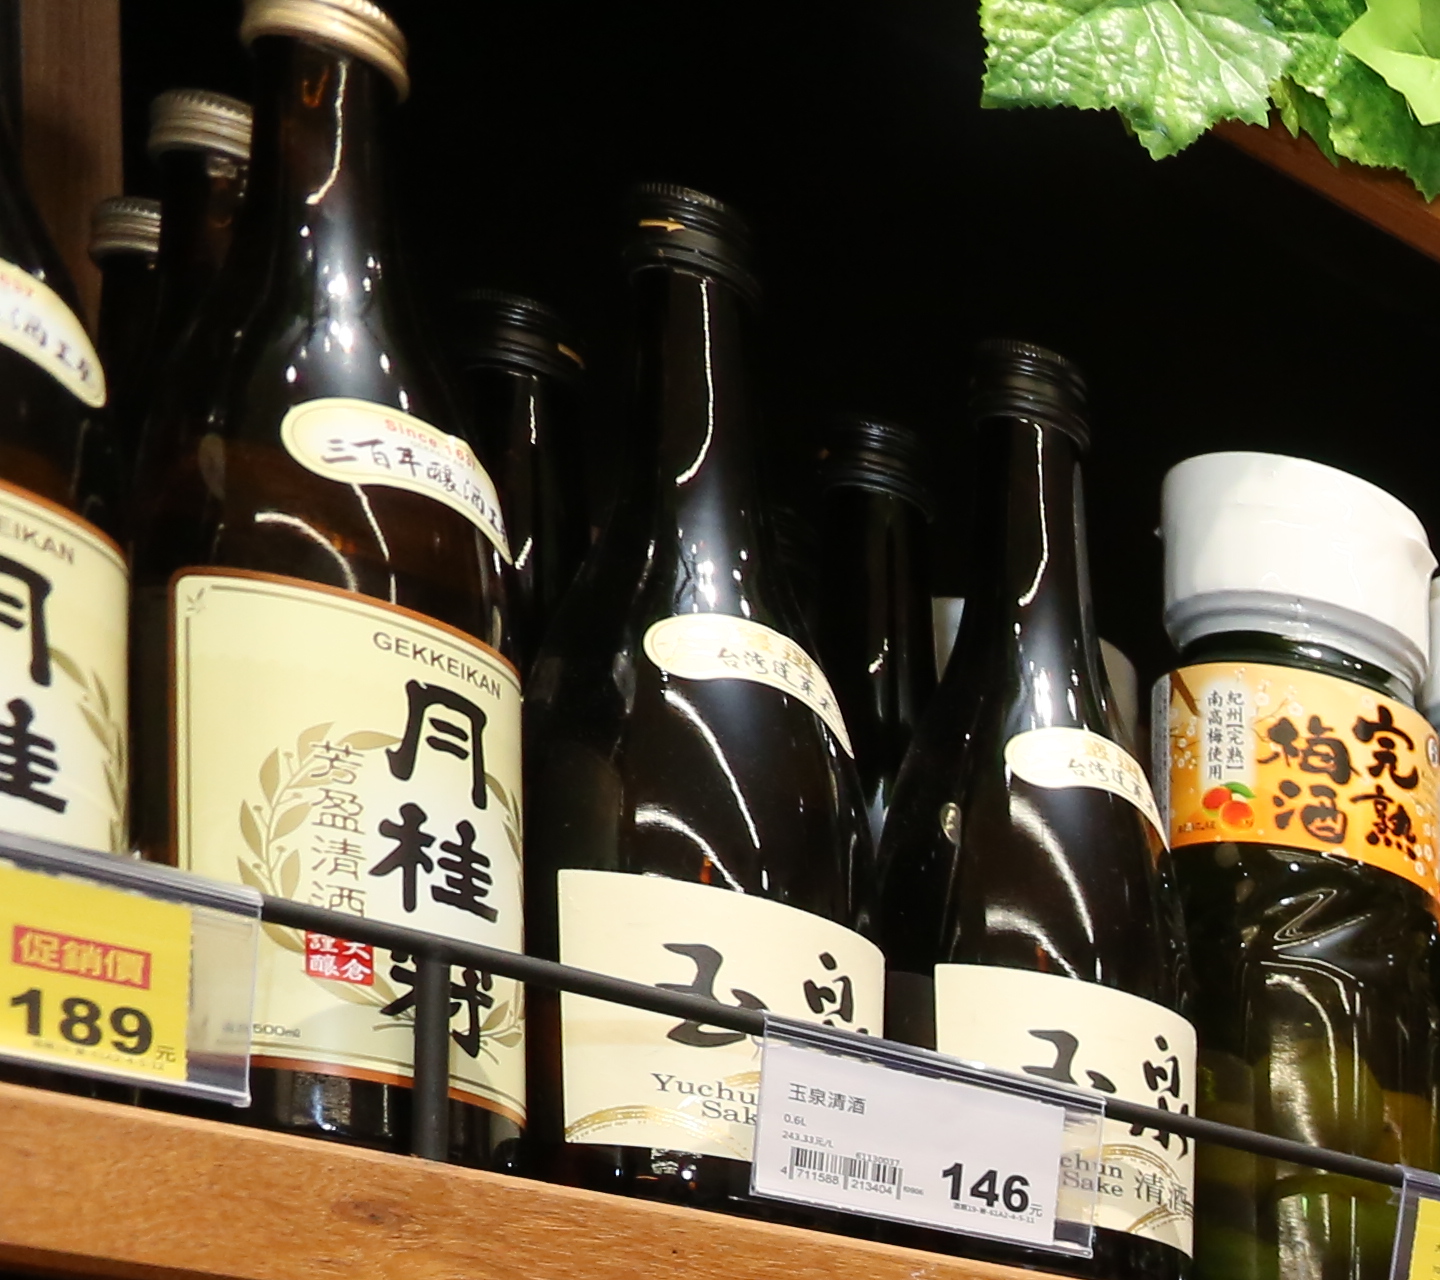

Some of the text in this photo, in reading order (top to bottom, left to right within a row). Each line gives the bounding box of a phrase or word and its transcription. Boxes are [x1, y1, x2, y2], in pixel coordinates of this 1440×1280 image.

[385, 418, 437, 447] Since
[373, 630, 501, 700] GEKKEIKAN
[1258, 715, 1360, 845] 梅酒
[1351, 704, 1418, 861] 完熟
[19, 930, 146, 985] 促銷價
[10, 987, 153, 1055] 189
[701, 1100, 759, 1126] Sak
[784, 1113, 807, 1128] 0.6L
[788, 1082, 866, 1116] 玉泉清酒
[796, 1167, 893, 1196] 711588 213404
[942, 1162, 1030, 1213] 146
[1029, 1204, 1043, 1218] 元
